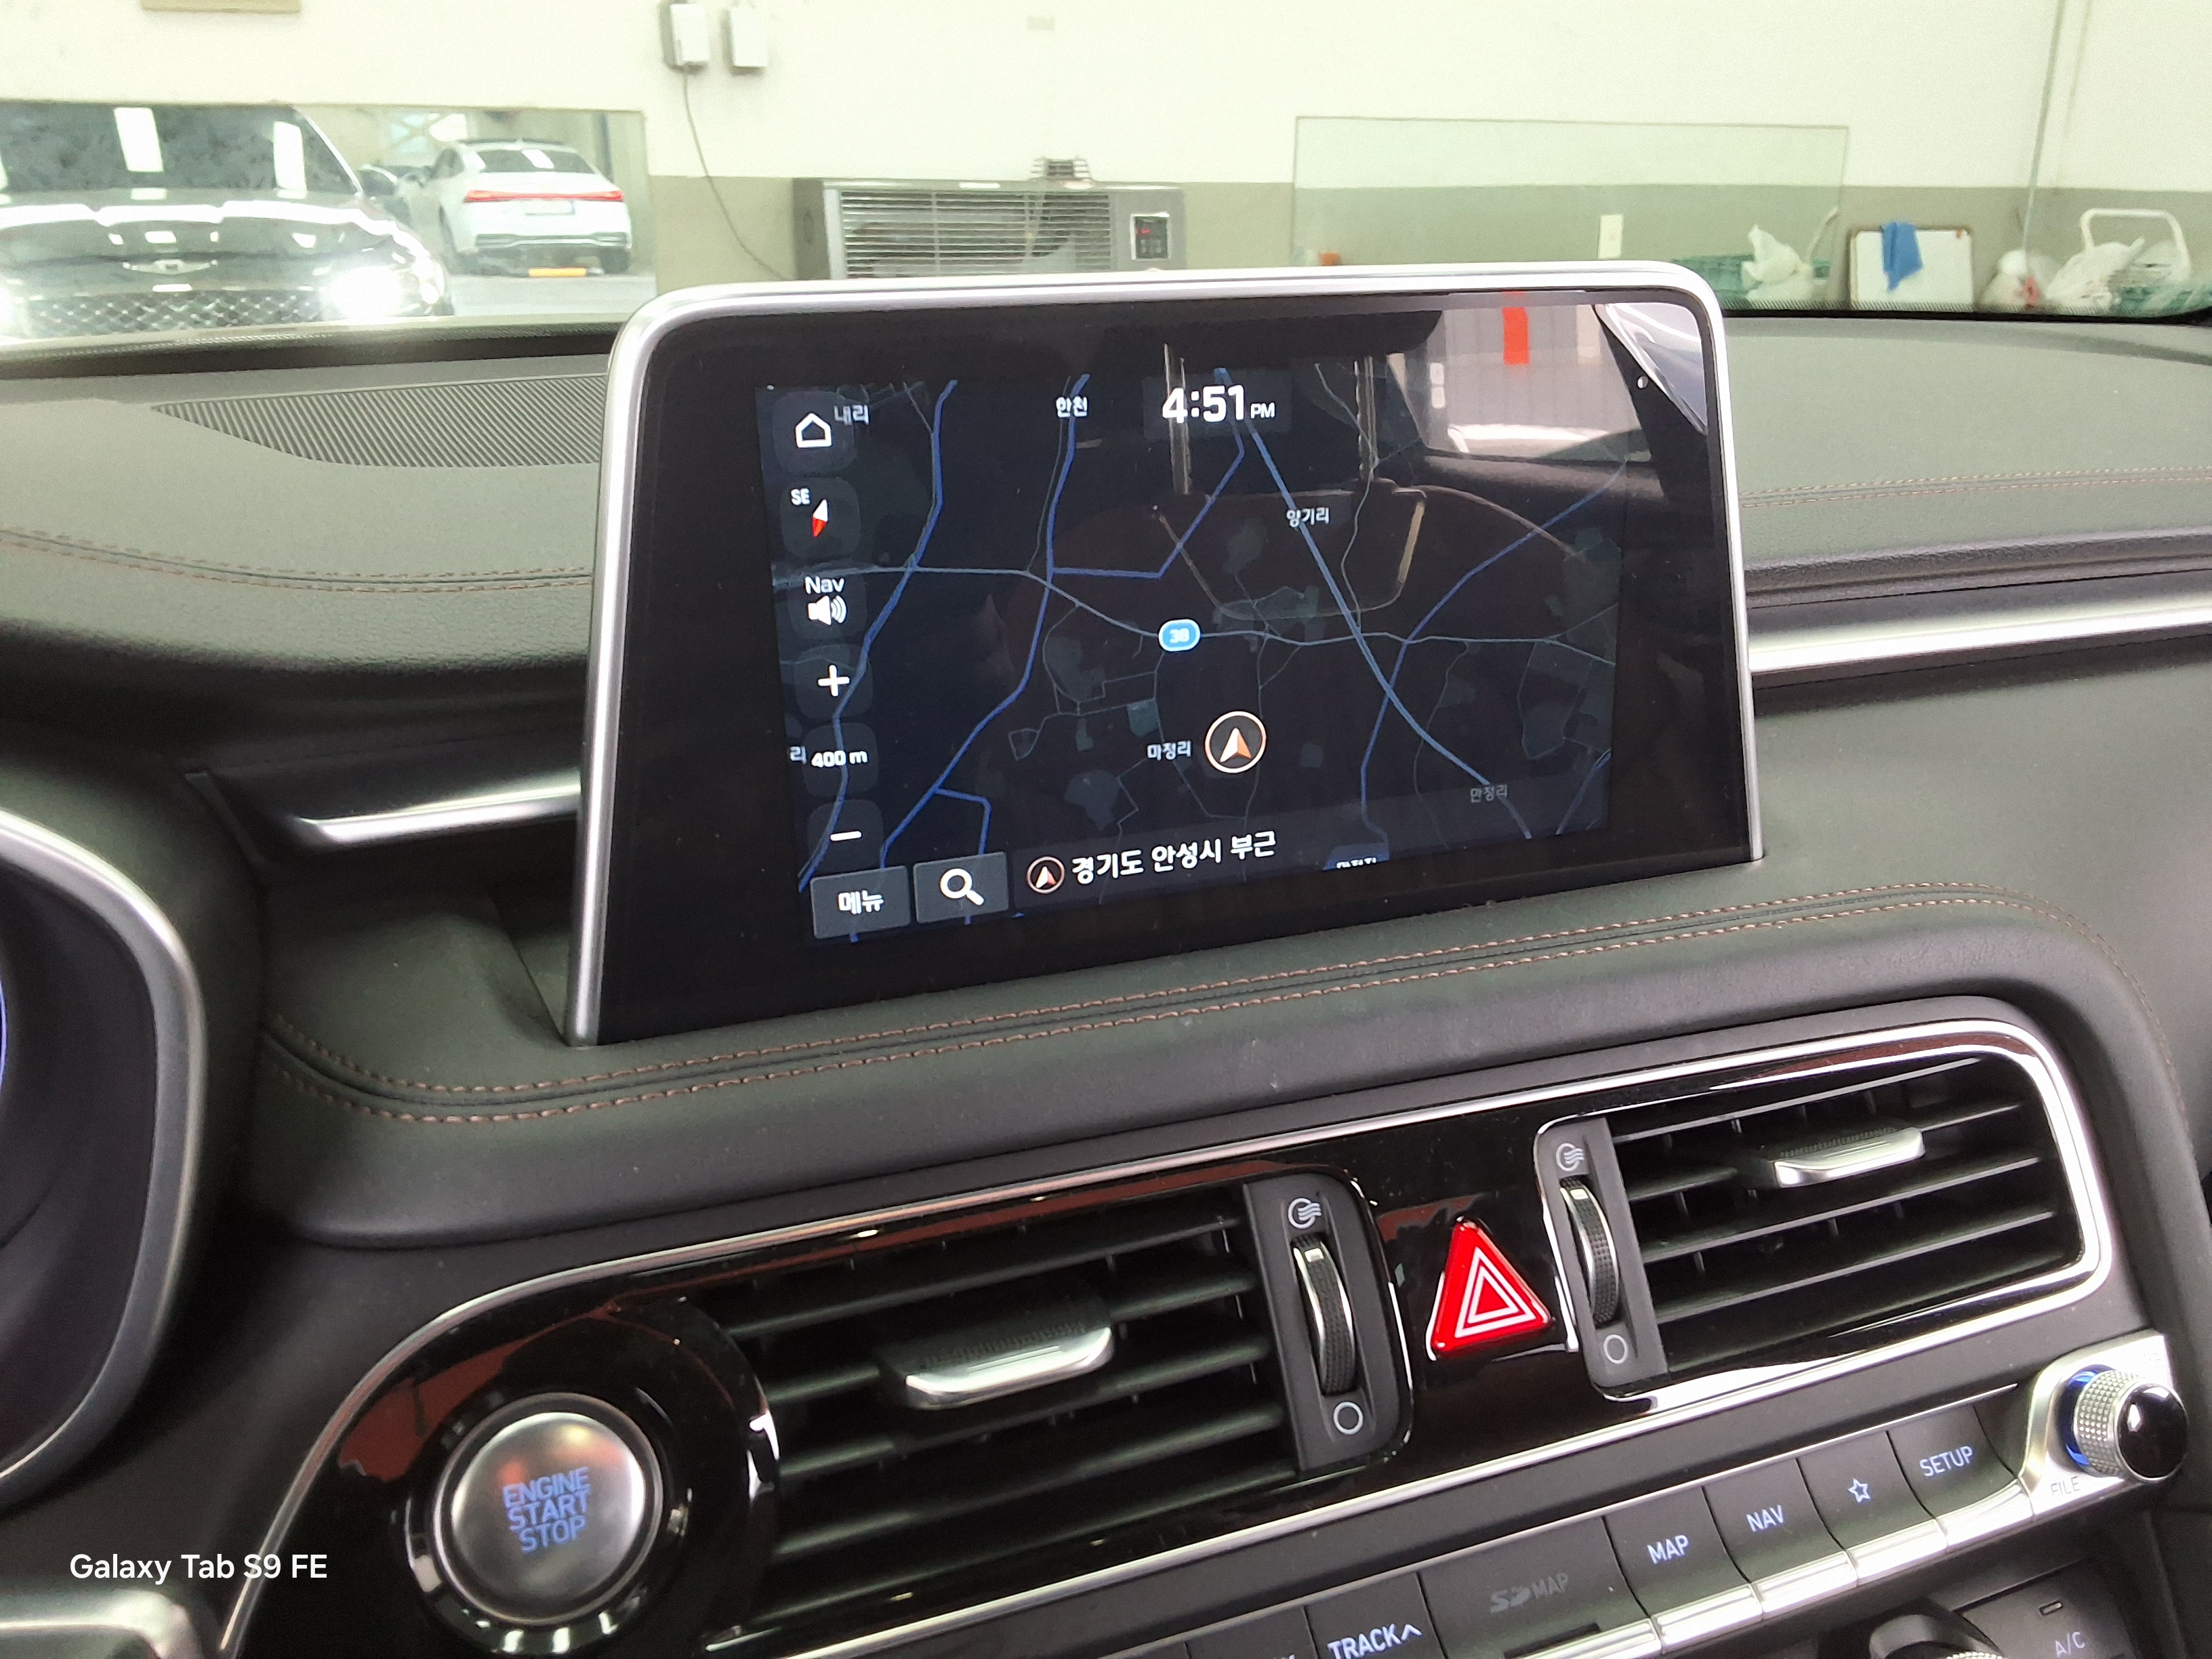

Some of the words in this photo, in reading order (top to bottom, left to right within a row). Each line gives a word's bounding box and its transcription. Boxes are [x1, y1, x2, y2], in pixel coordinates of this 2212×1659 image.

[834, 404, 869, 426] 내리
[1162, 384, 1245, 424] 4:51
[1250, 402, 1275, 419] PM
[790, 488, 811, 506] SE
[804, 575, 846, 594] Nav
[811, 750, 846, 768] 400
[848, 750, 868, 764] m
[1071, 849, 1145, 885] 경기도
[1151, 838, 1223, 873] 안성시
[1230, 830, 1277, 860] 부근
[838, 889, 885, 915] 메뉴
[1919, 1445, 1974, 1477] SETUP
[503, 1466, 590, 1508] ENGINE
[2050, 1475, 2081, 1497] FILE
[508, 1488, 591, 1533] START
[1746, 1504, 1784, 1532] NAV
[519, 1514, 587, 1553] STOP
[1647, 1534, 1689, 1564] MAP
[1532, 1572, 1569, 1599] MAP
[1327, 1623, 1401, 1659] TRACK
[2055, 1631, 2085, 1658] A/C
